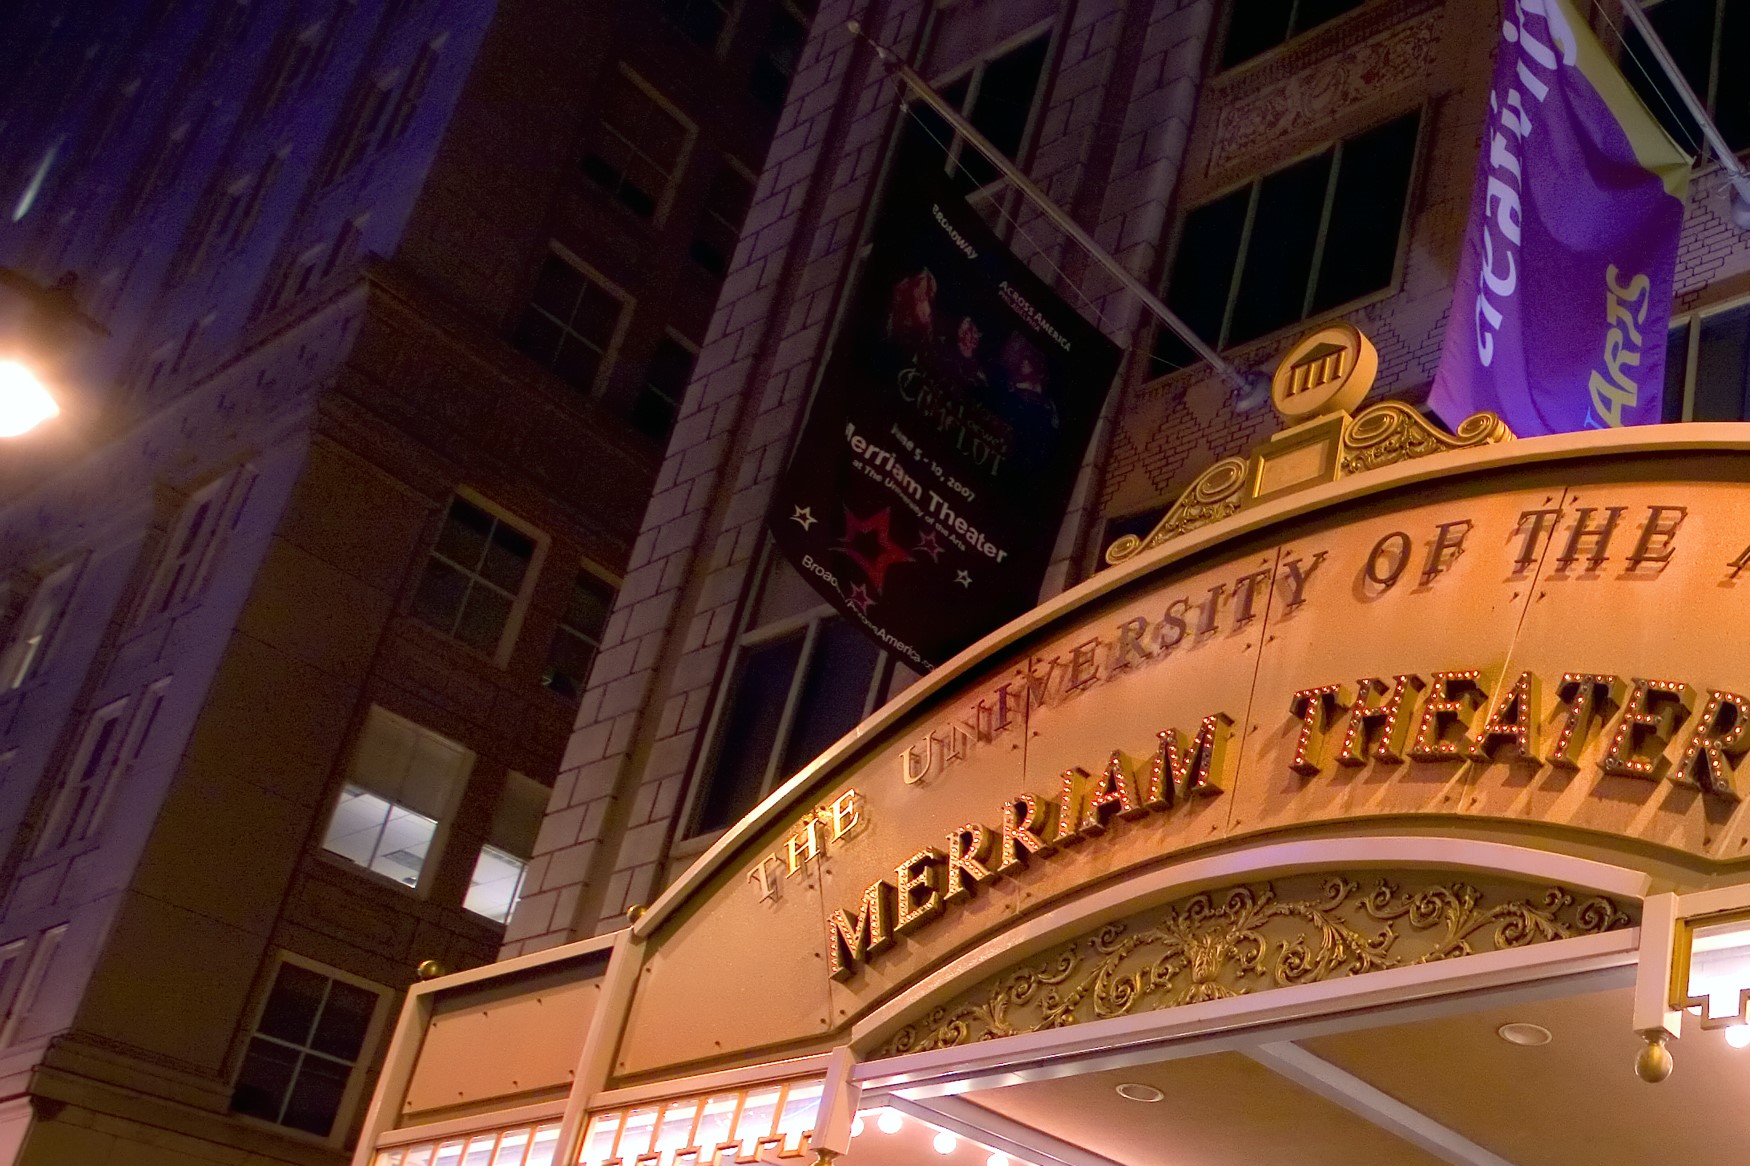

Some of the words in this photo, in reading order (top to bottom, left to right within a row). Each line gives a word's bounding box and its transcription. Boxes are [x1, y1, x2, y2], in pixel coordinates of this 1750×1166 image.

[931, 203, 979, 260] BROADWAY
[998, 280, 1035, 316] ACROSS
[1033, 312, 1071, 352] AMERICA
[852, 459, 864, 470] at
[864, 465, 883, 483] The
[924, 515, 935, 525] of
[935, 522, 949, 537] the
[948, 534, 966, 551] Arts
[913, 447, 923, 461] 5
[946, 476, 977, 503] 2007
[928, 489, 1009, 564] Theater
[747, 787, 861, 903] THE
[899, 550, 1330, 786] UNIVERSITY
[1364, 518, 1473, 588] OF
[1513, 504, 1688, 576] THE
[826, 712, 1234, 982] MERRIAM
